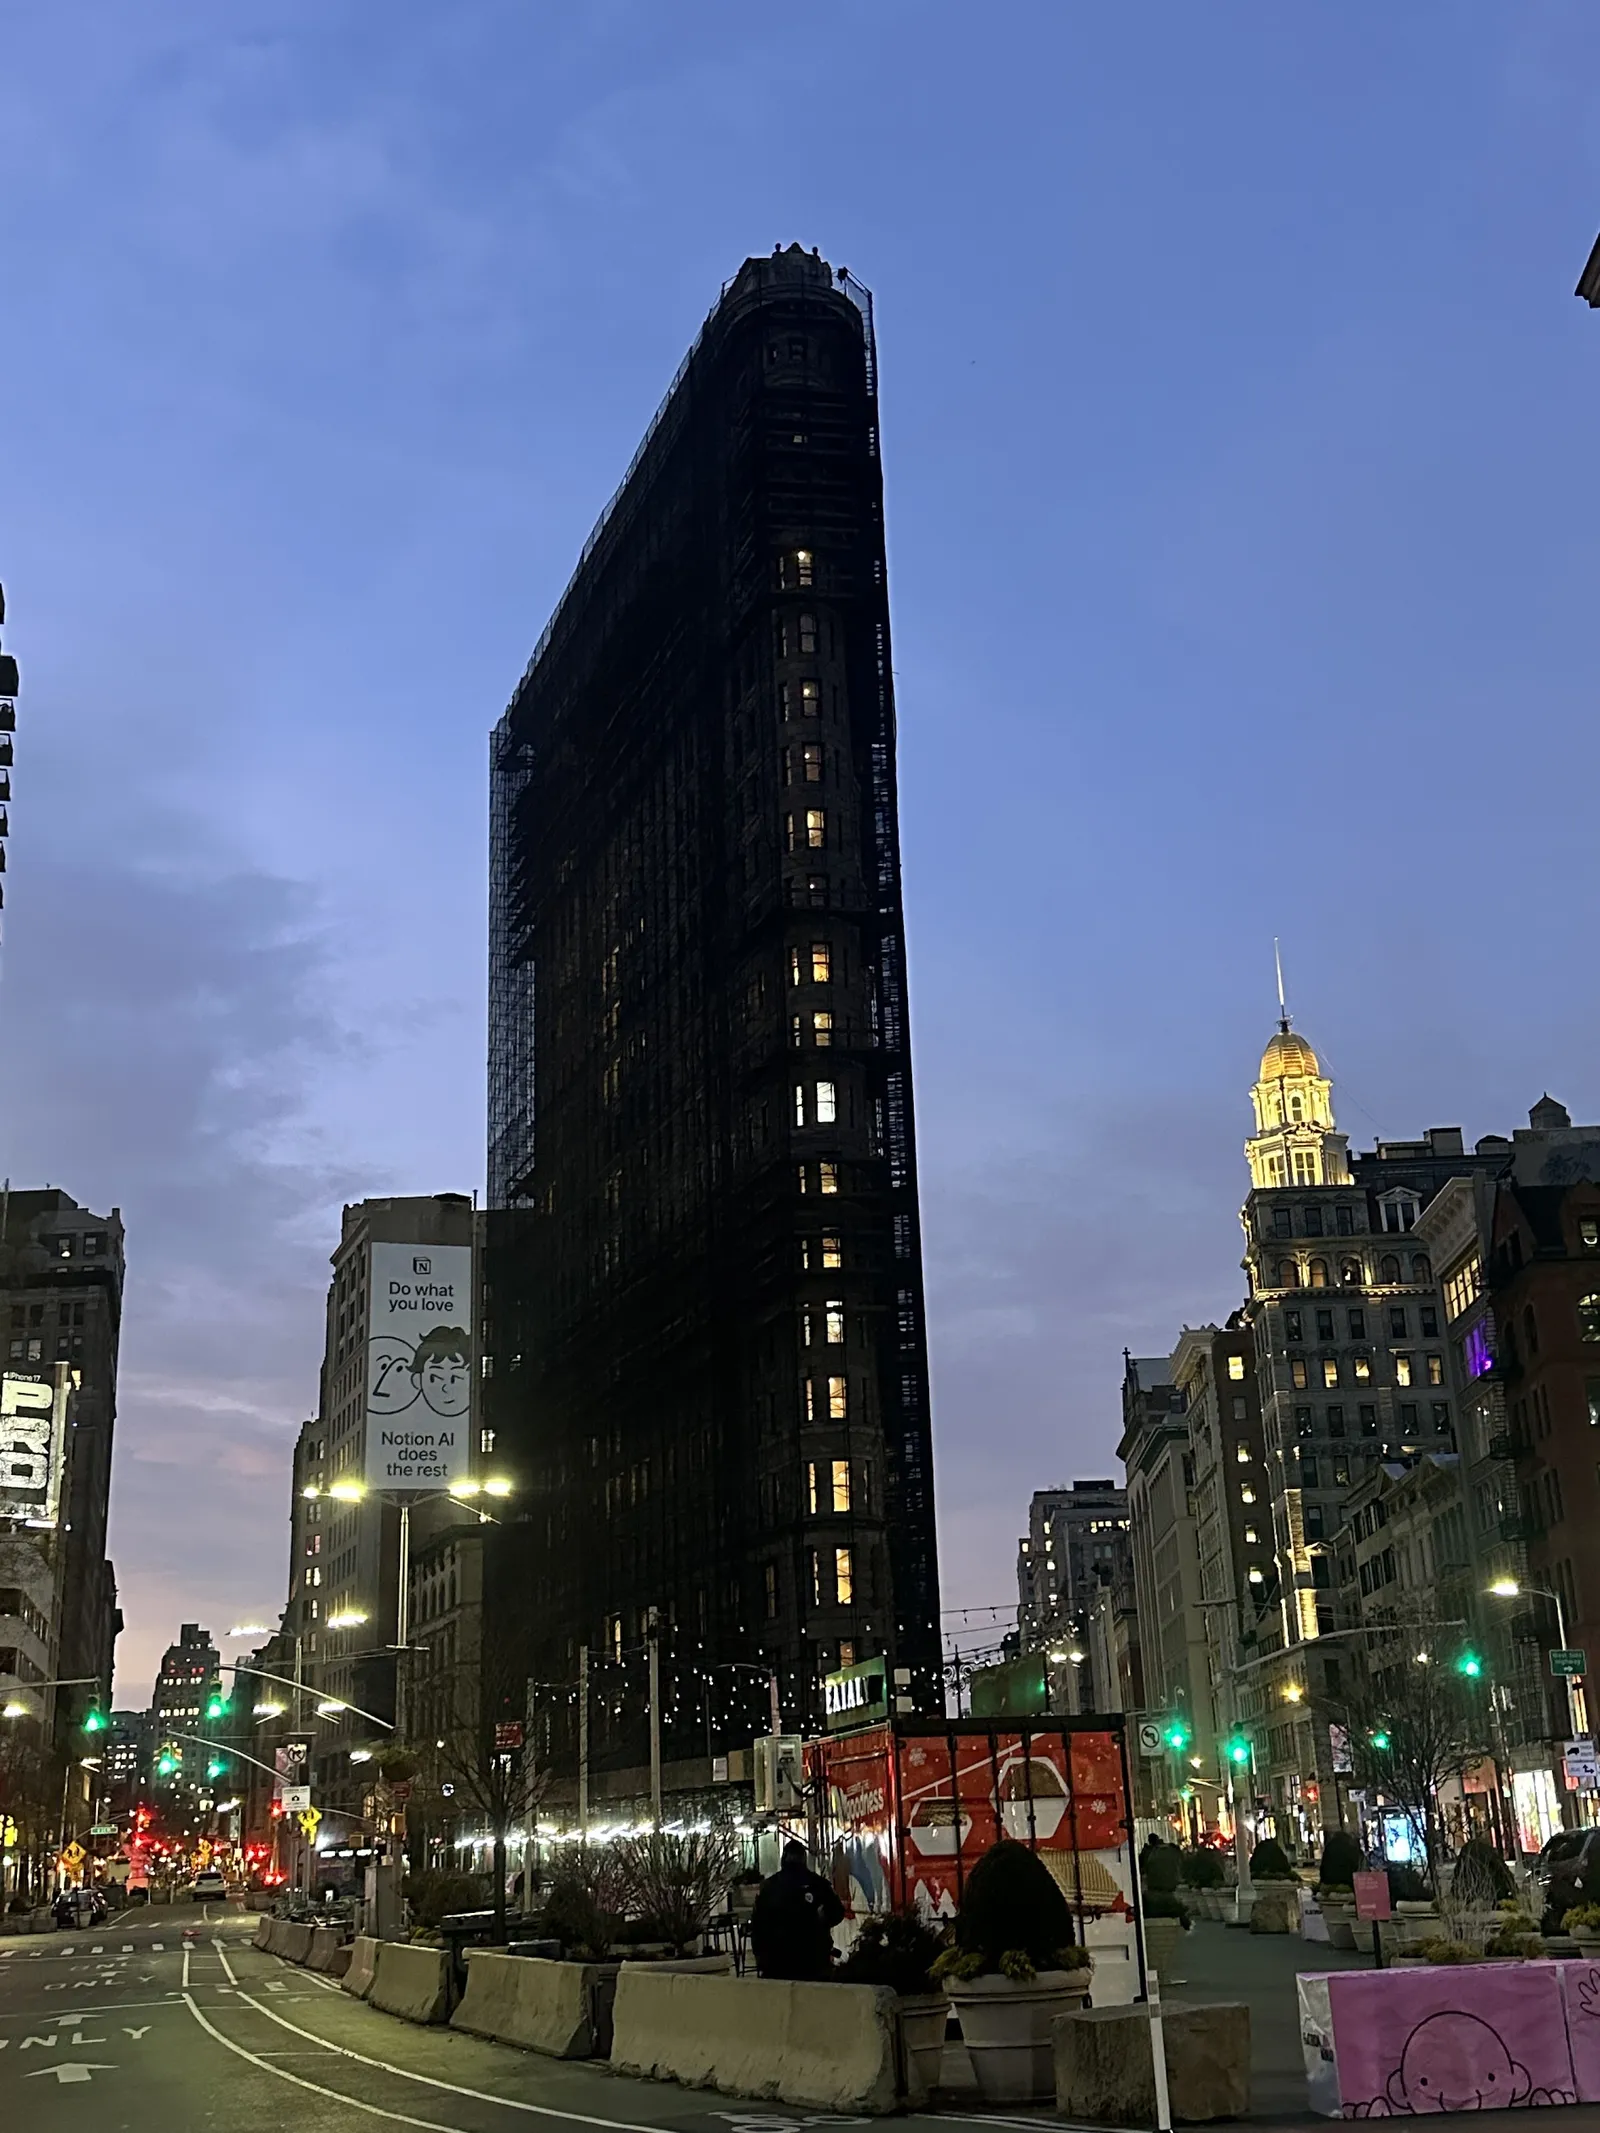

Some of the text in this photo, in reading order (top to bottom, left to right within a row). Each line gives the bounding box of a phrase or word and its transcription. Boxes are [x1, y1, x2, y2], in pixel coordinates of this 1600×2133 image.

[418, 1262, 428, 1272] N
[389, 1281, 454, 1297] Do what
[389, 1298, 454, 1313] you love
[9, 1371, 41, 1382] iPhone 17
[0, 1379, 53, 1489] PRO
[381, 1431, 454, 1446] Notion AI
[398, 1447, 438, 1461] does
[386, 1462, 448, 1477] the rest
[44, 1975, 155, 1990] ONLY
